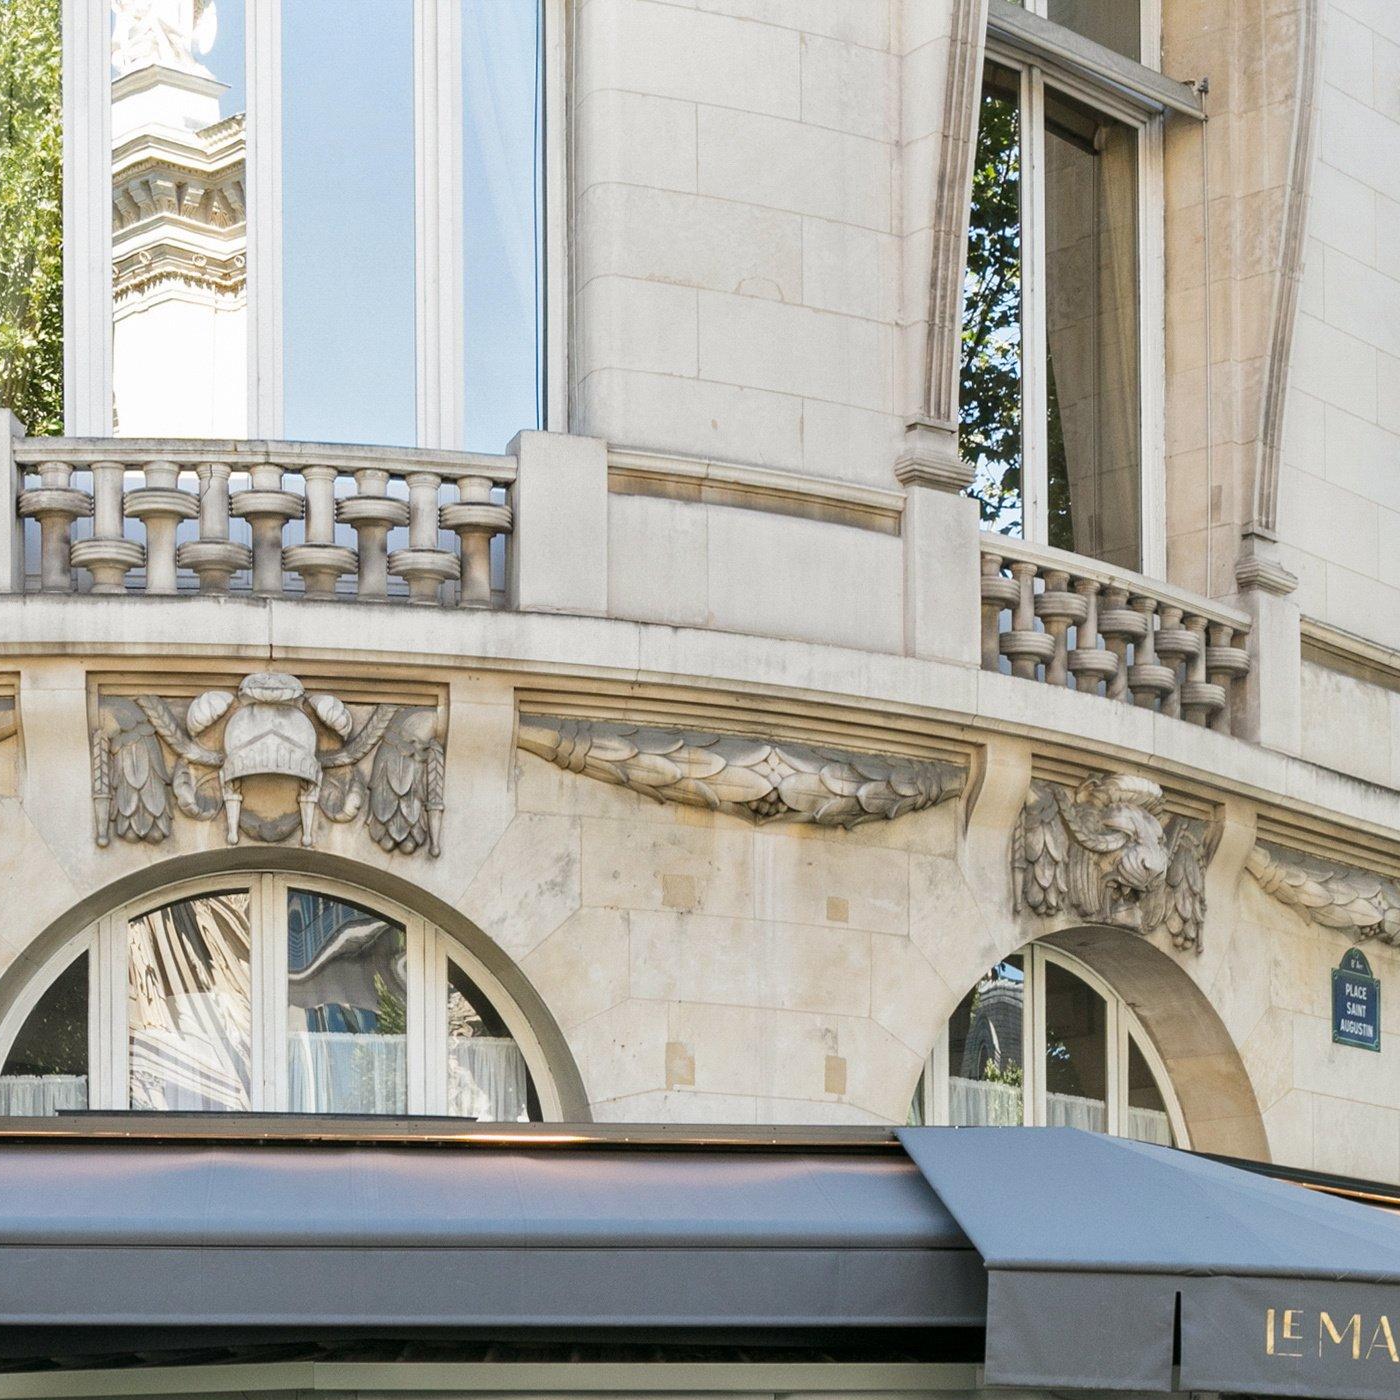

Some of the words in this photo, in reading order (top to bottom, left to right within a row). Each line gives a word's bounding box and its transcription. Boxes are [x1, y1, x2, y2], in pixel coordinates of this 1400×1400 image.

[1345, 983, 1367, 1000] PLACE
[1346, 1002, 1366, 1018] SAINT
[1340, 1018, 1373, 1038] AUGUSTIN
[1266, 1308, 1304, 1358] LE
